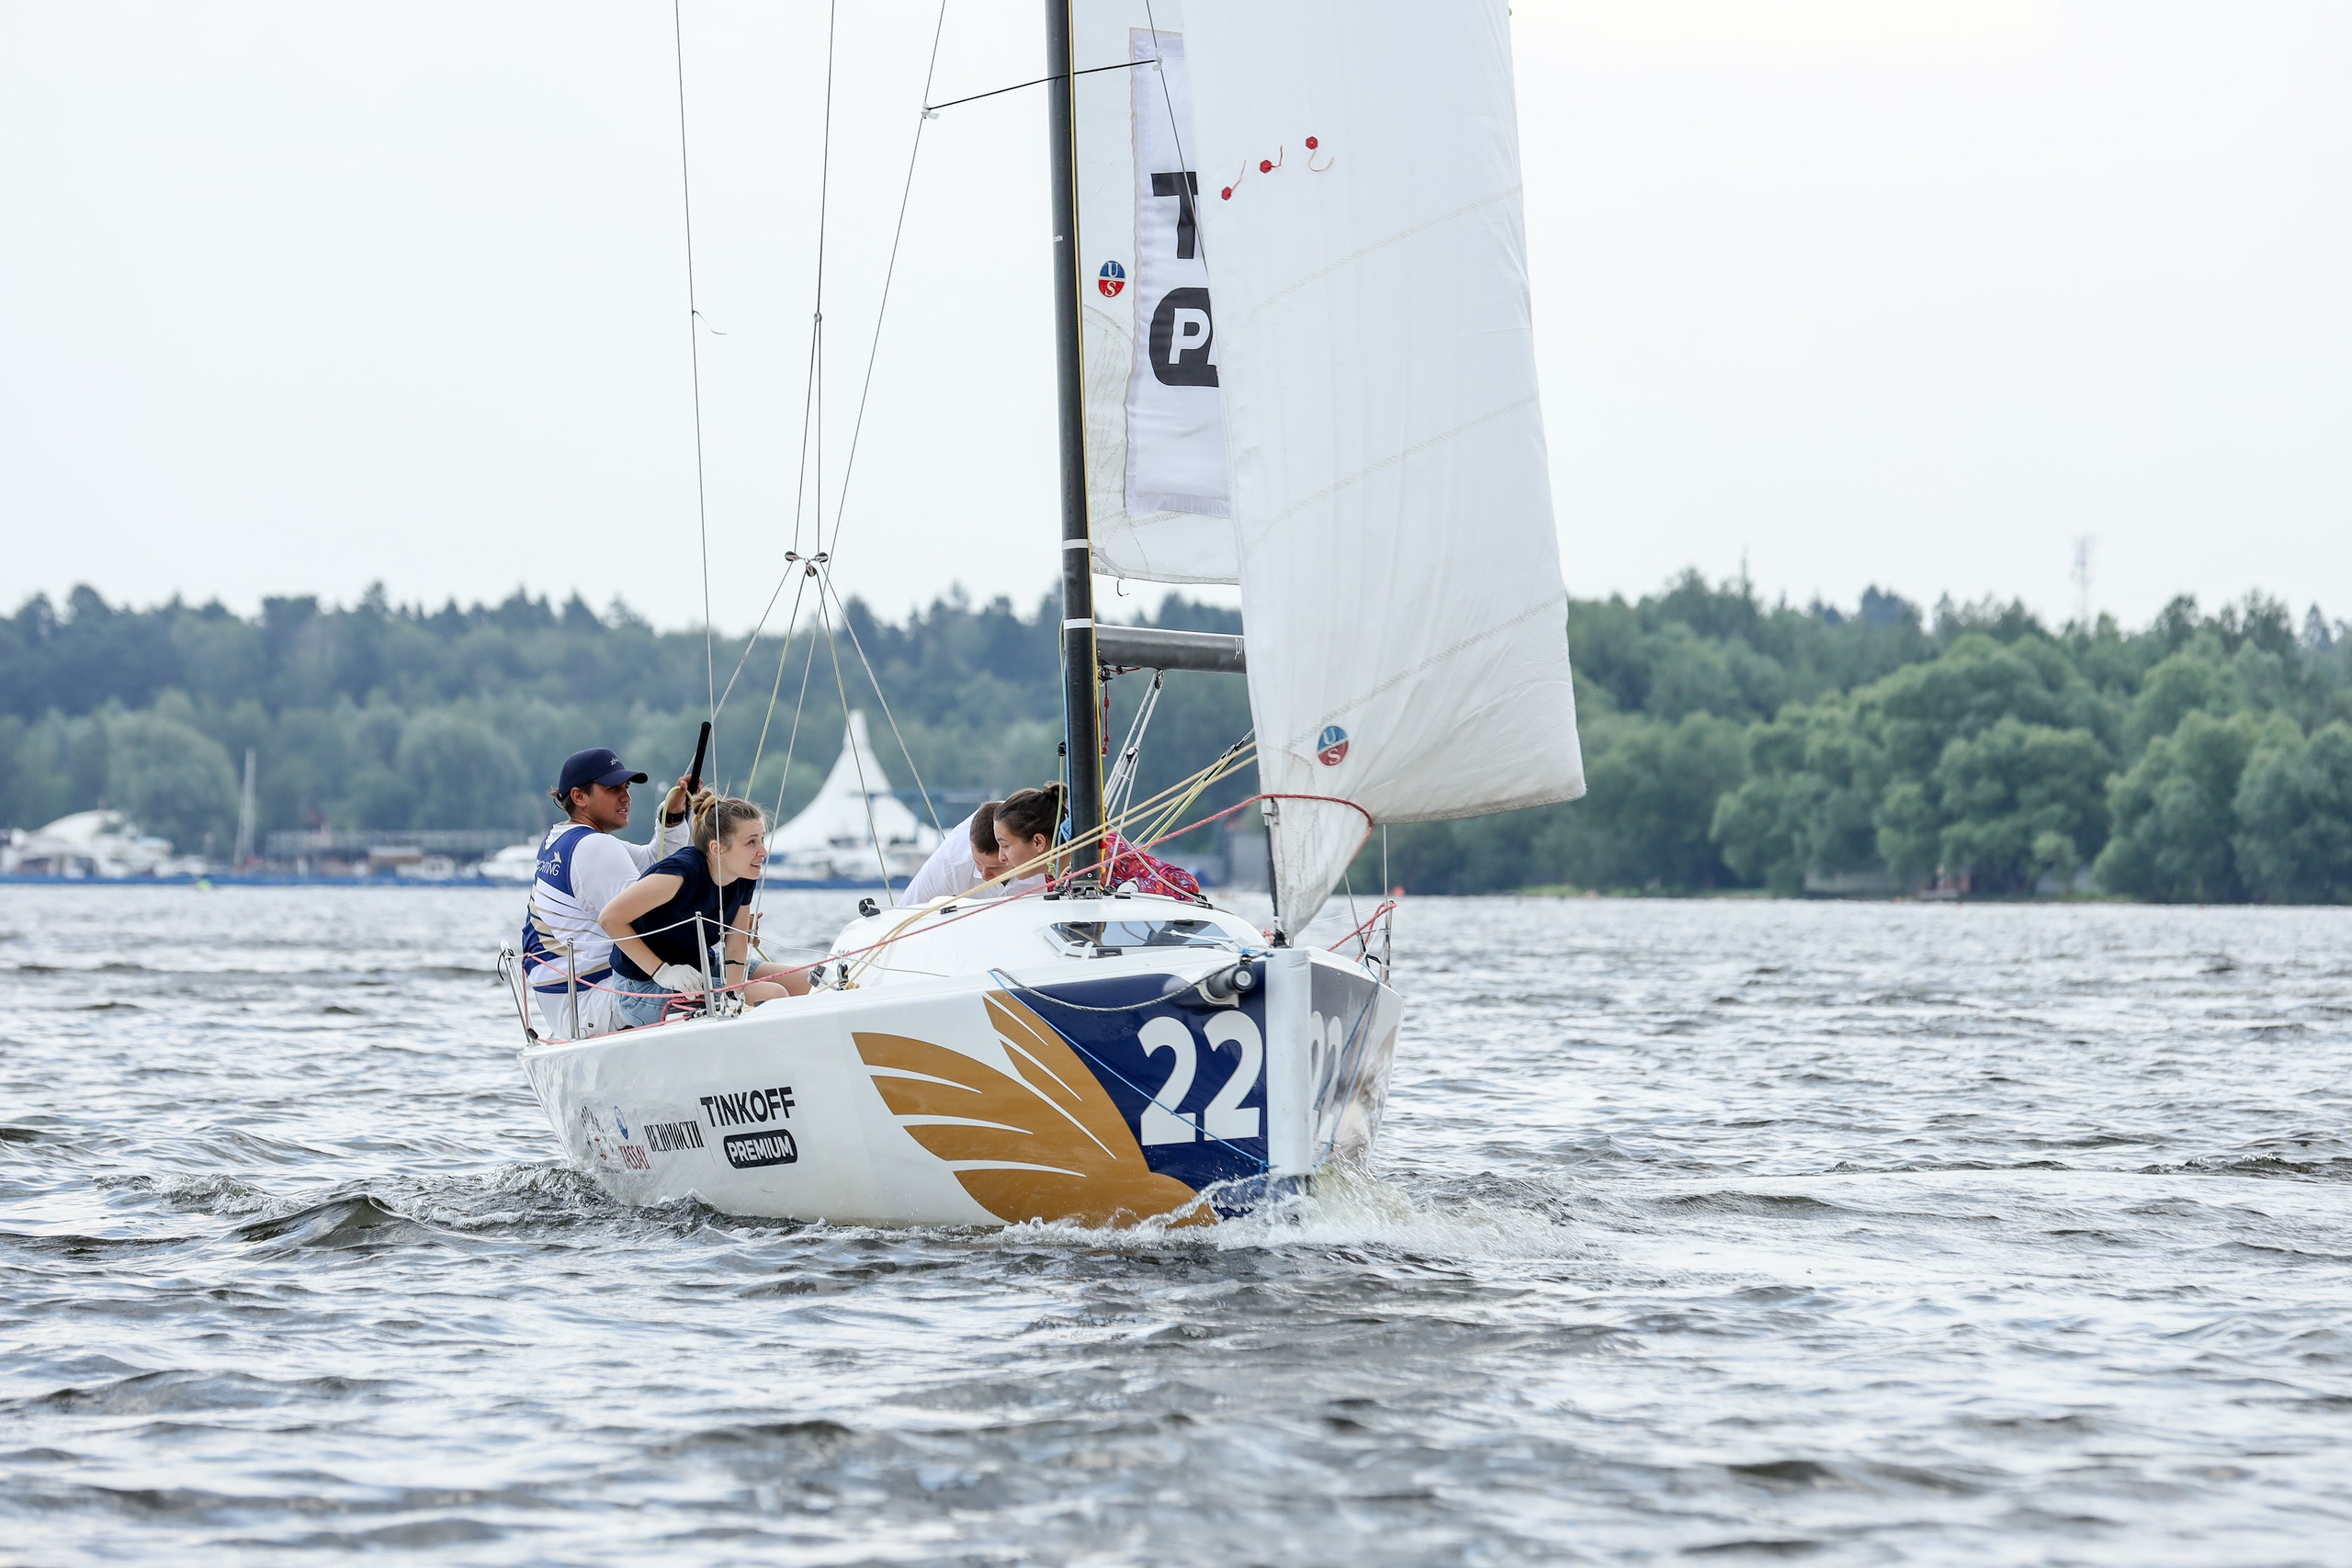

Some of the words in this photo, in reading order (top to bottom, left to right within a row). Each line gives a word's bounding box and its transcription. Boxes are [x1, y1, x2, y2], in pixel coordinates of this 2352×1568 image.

[1151, 172, 1198, 259] T
[1136, 1010, 1263, 1146] 22
[699, 1086, 797, 1128] TINKOFF
[643, 1121, 705, 1154] ВЕДОМОСТИ
[726, 1135, 795, 1163] PREMIUM
[617, 1145, 651, 1170] TASSAY
